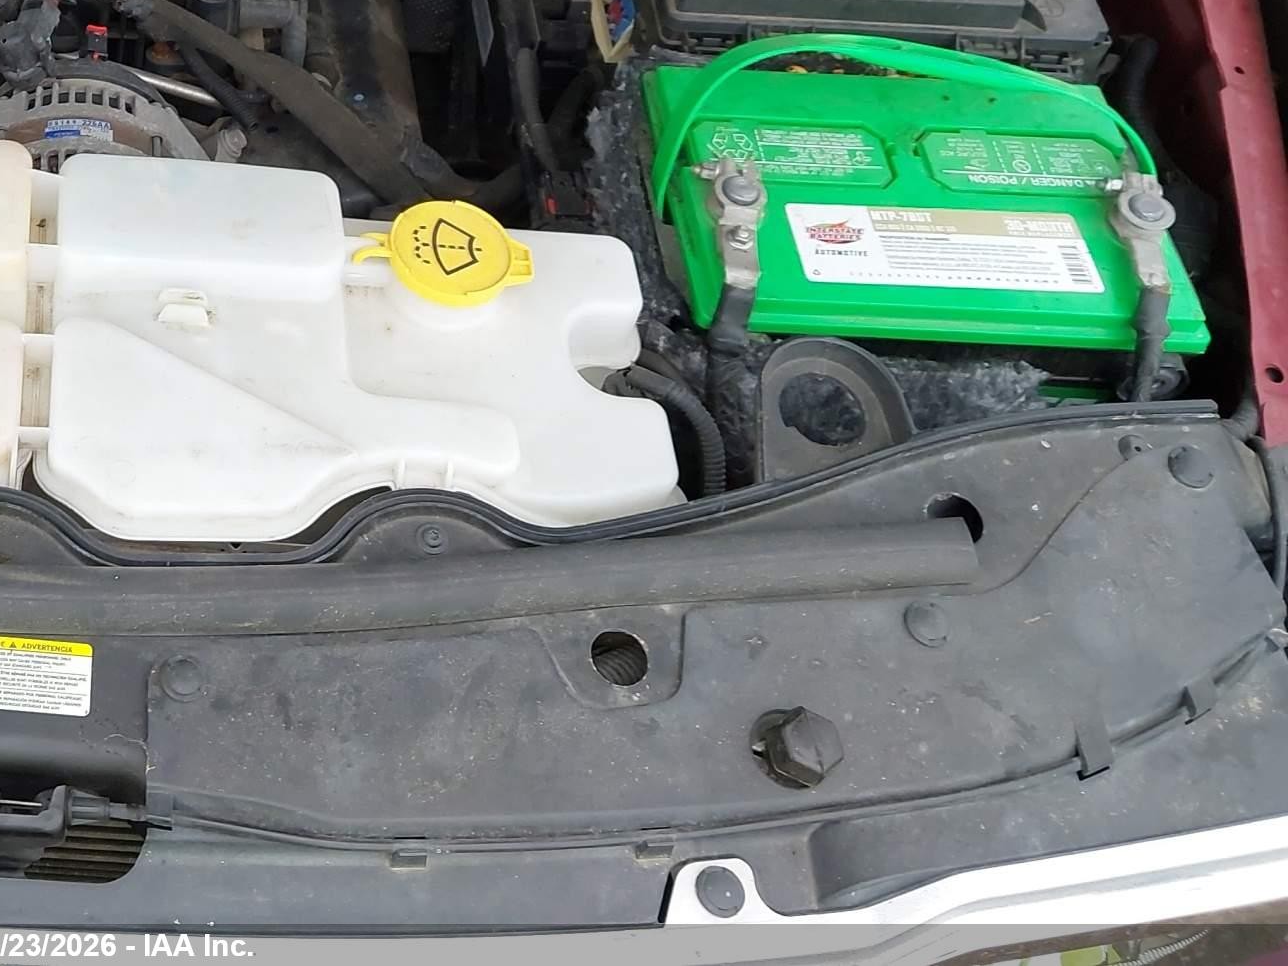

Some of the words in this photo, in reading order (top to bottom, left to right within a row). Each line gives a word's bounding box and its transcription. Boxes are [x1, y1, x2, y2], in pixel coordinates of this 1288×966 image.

[806, 226, 864, 235] INTERSTATE
[815, 249, 868, 257] AUTOMOTIVE
[21, 643, 73, 653] ADVERTENCIA
